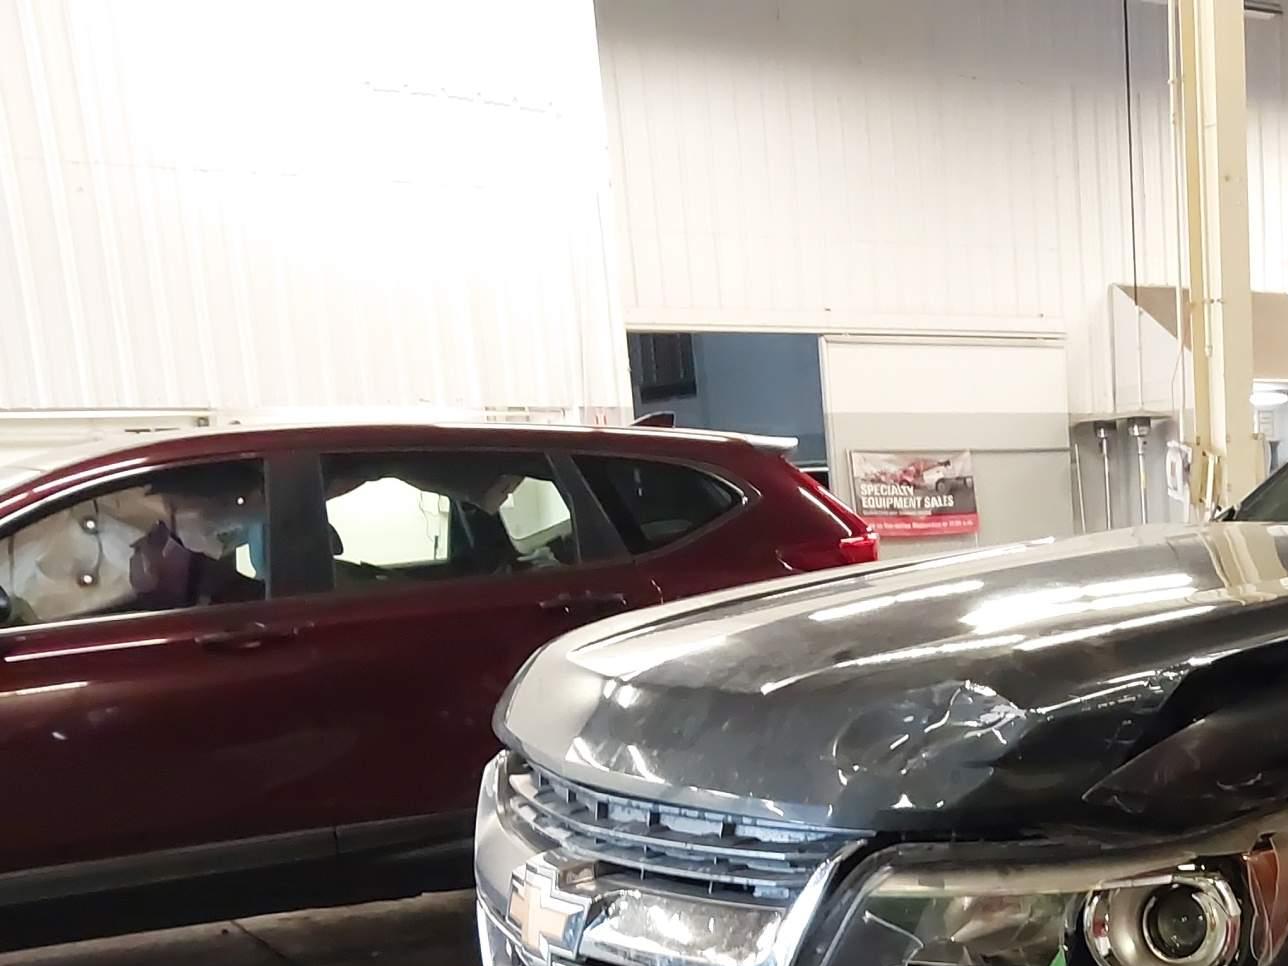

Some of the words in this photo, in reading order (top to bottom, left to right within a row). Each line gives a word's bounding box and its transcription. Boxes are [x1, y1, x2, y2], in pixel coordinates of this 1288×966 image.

[860, 483, 914, 496] SPECIALTY
[861, 495, 922, 509] EQUIPMENT
[924, 494, 954, 508] SALES
